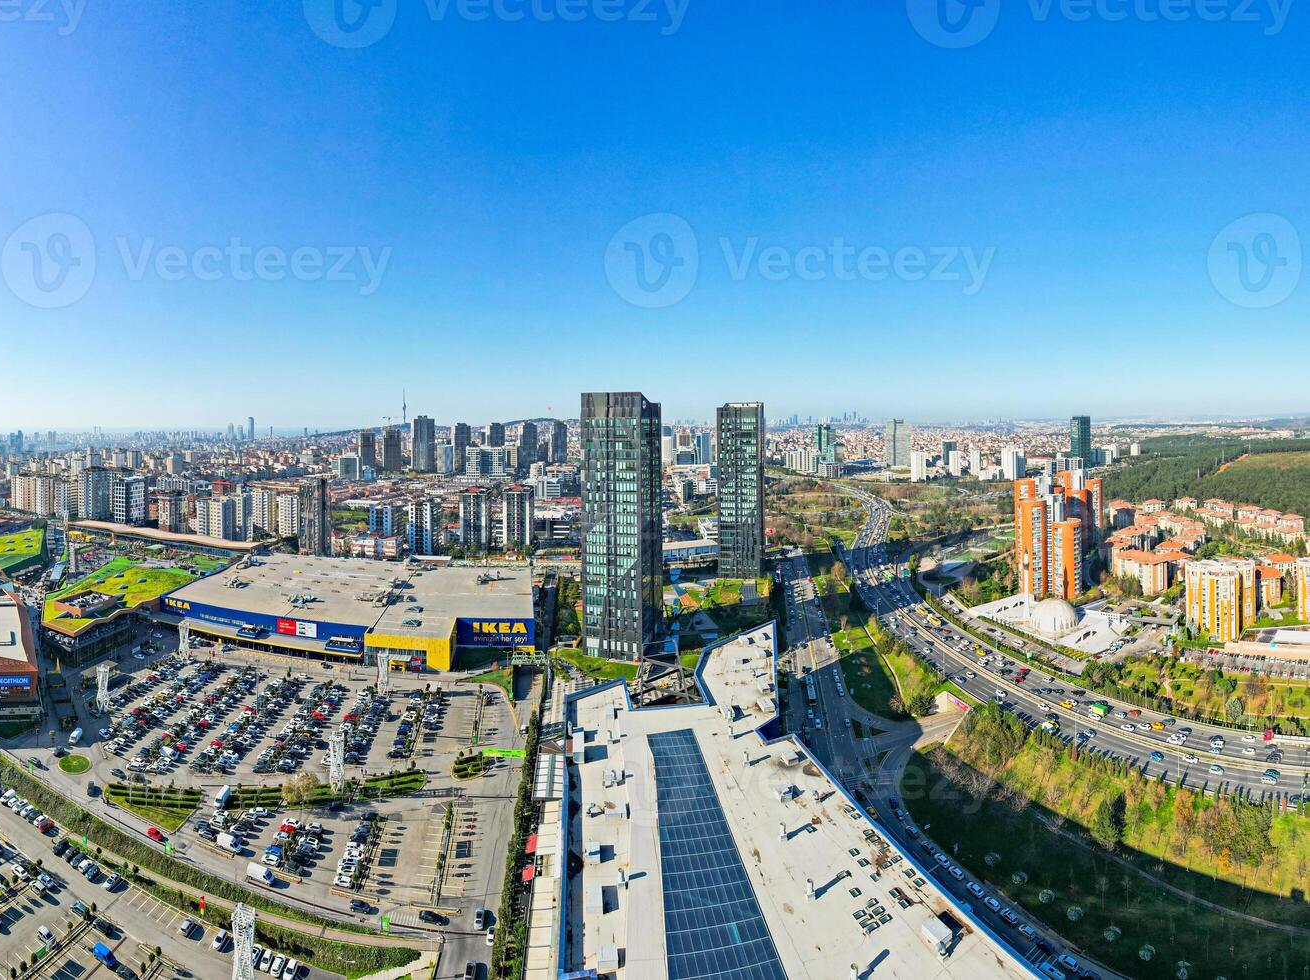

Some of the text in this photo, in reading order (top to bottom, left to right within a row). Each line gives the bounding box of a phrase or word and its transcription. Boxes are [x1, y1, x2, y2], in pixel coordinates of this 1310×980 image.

[165, 598, 190, 610] IKEA
[473, 622, 527, 634] IKEA
[501, 634, 513, 642] her
